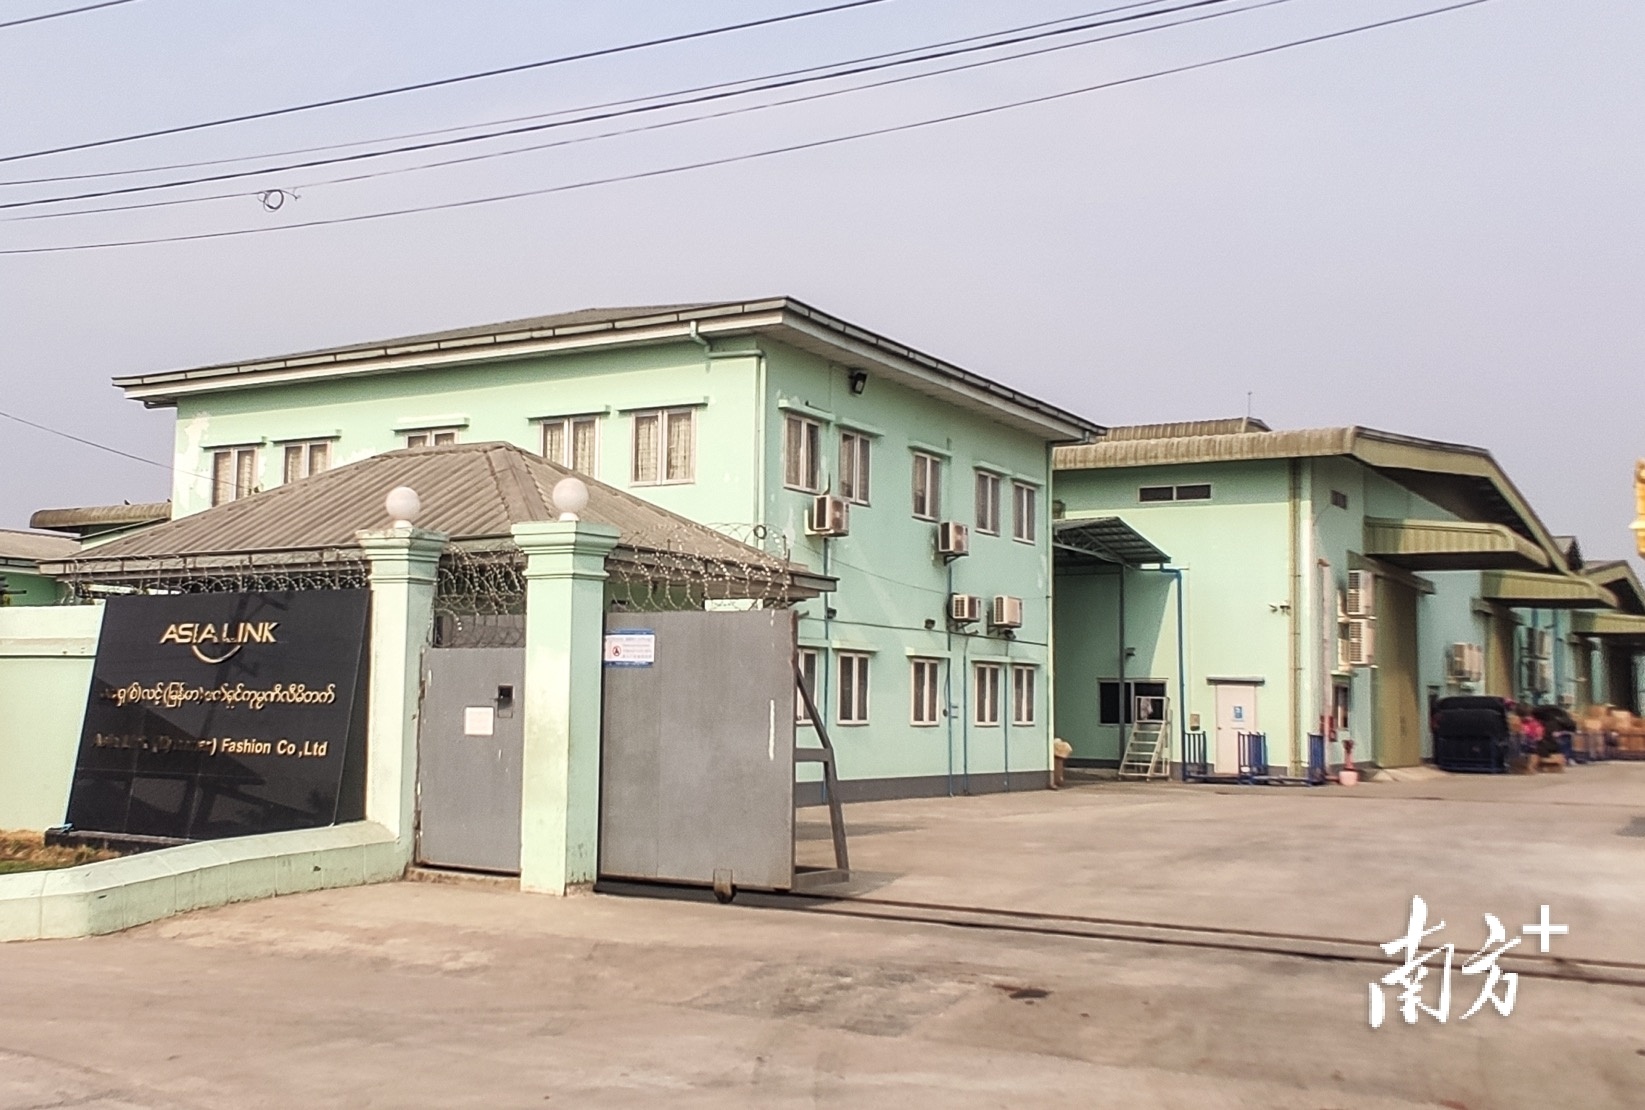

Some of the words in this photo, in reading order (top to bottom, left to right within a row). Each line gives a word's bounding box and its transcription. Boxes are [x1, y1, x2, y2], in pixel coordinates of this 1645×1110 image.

[159, 622, 219, 644] ASIA
[222, 621, 279, 643] LINK
[221, 738, 272, 755] Fashion
